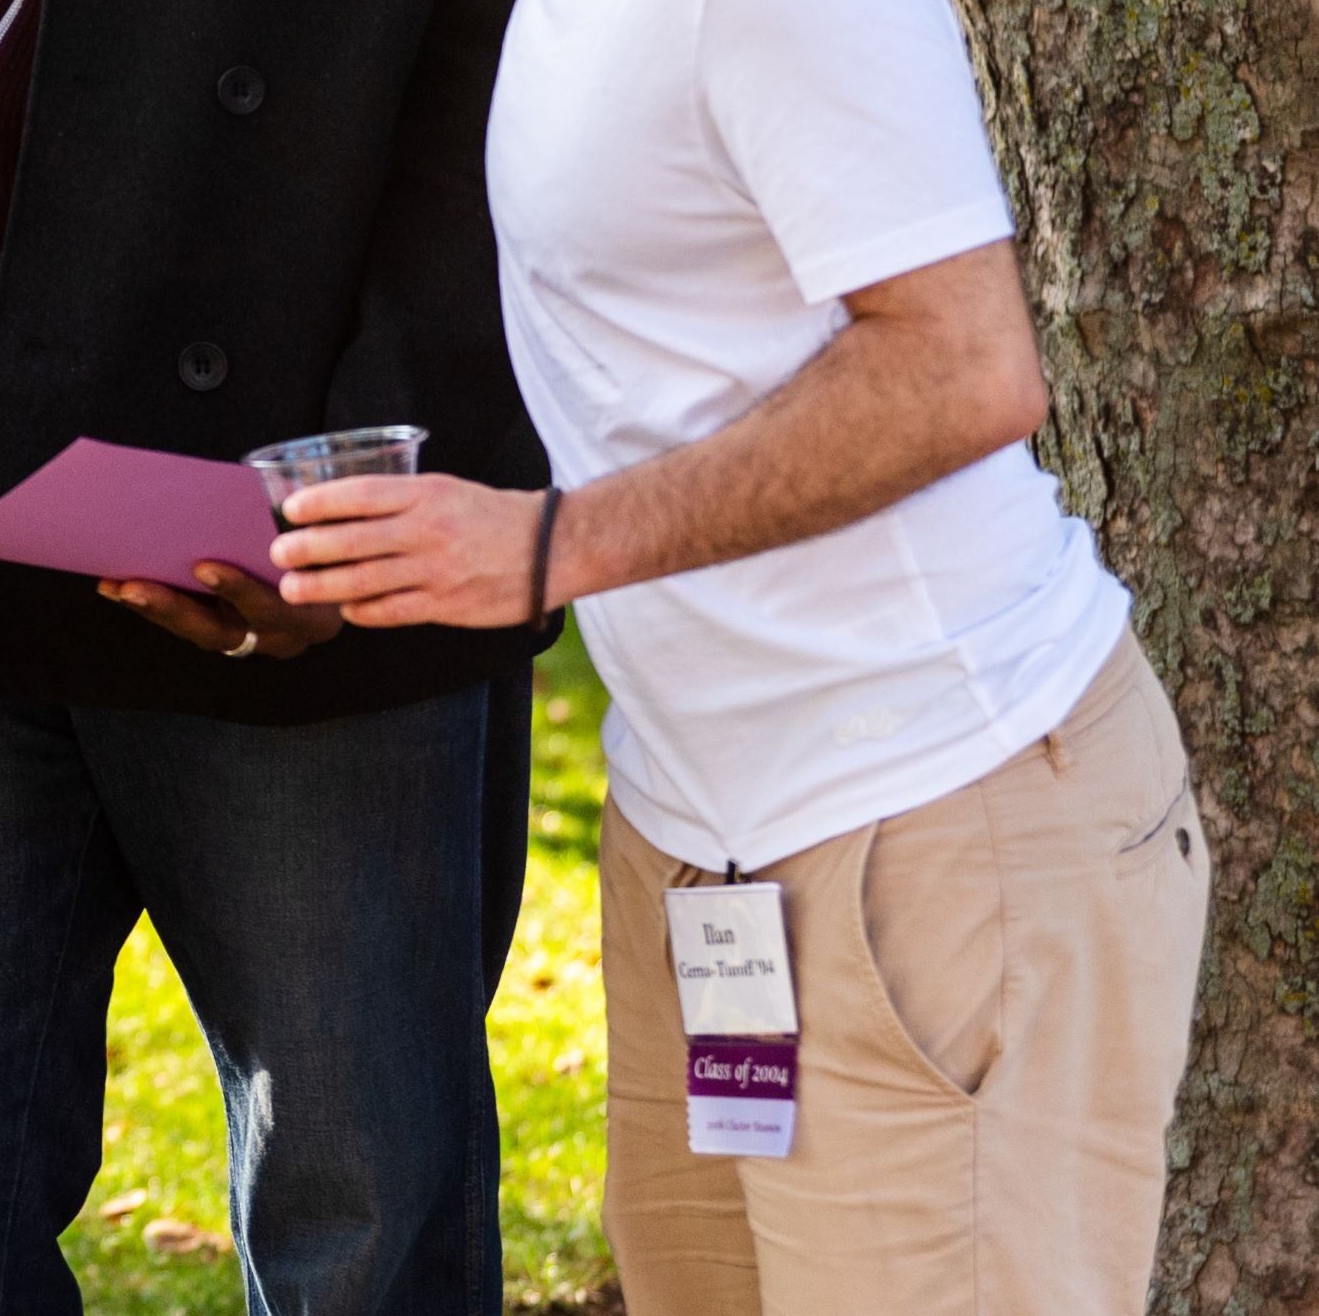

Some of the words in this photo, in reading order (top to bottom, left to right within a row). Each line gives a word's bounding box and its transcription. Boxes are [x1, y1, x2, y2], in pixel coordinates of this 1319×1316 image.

[702, 923, 735, 945] Ilan
[694, 1054, 732, 1080] Class
[734, 1056, 753, 1089] of
[751, 1064, 789, 1087] 2004
